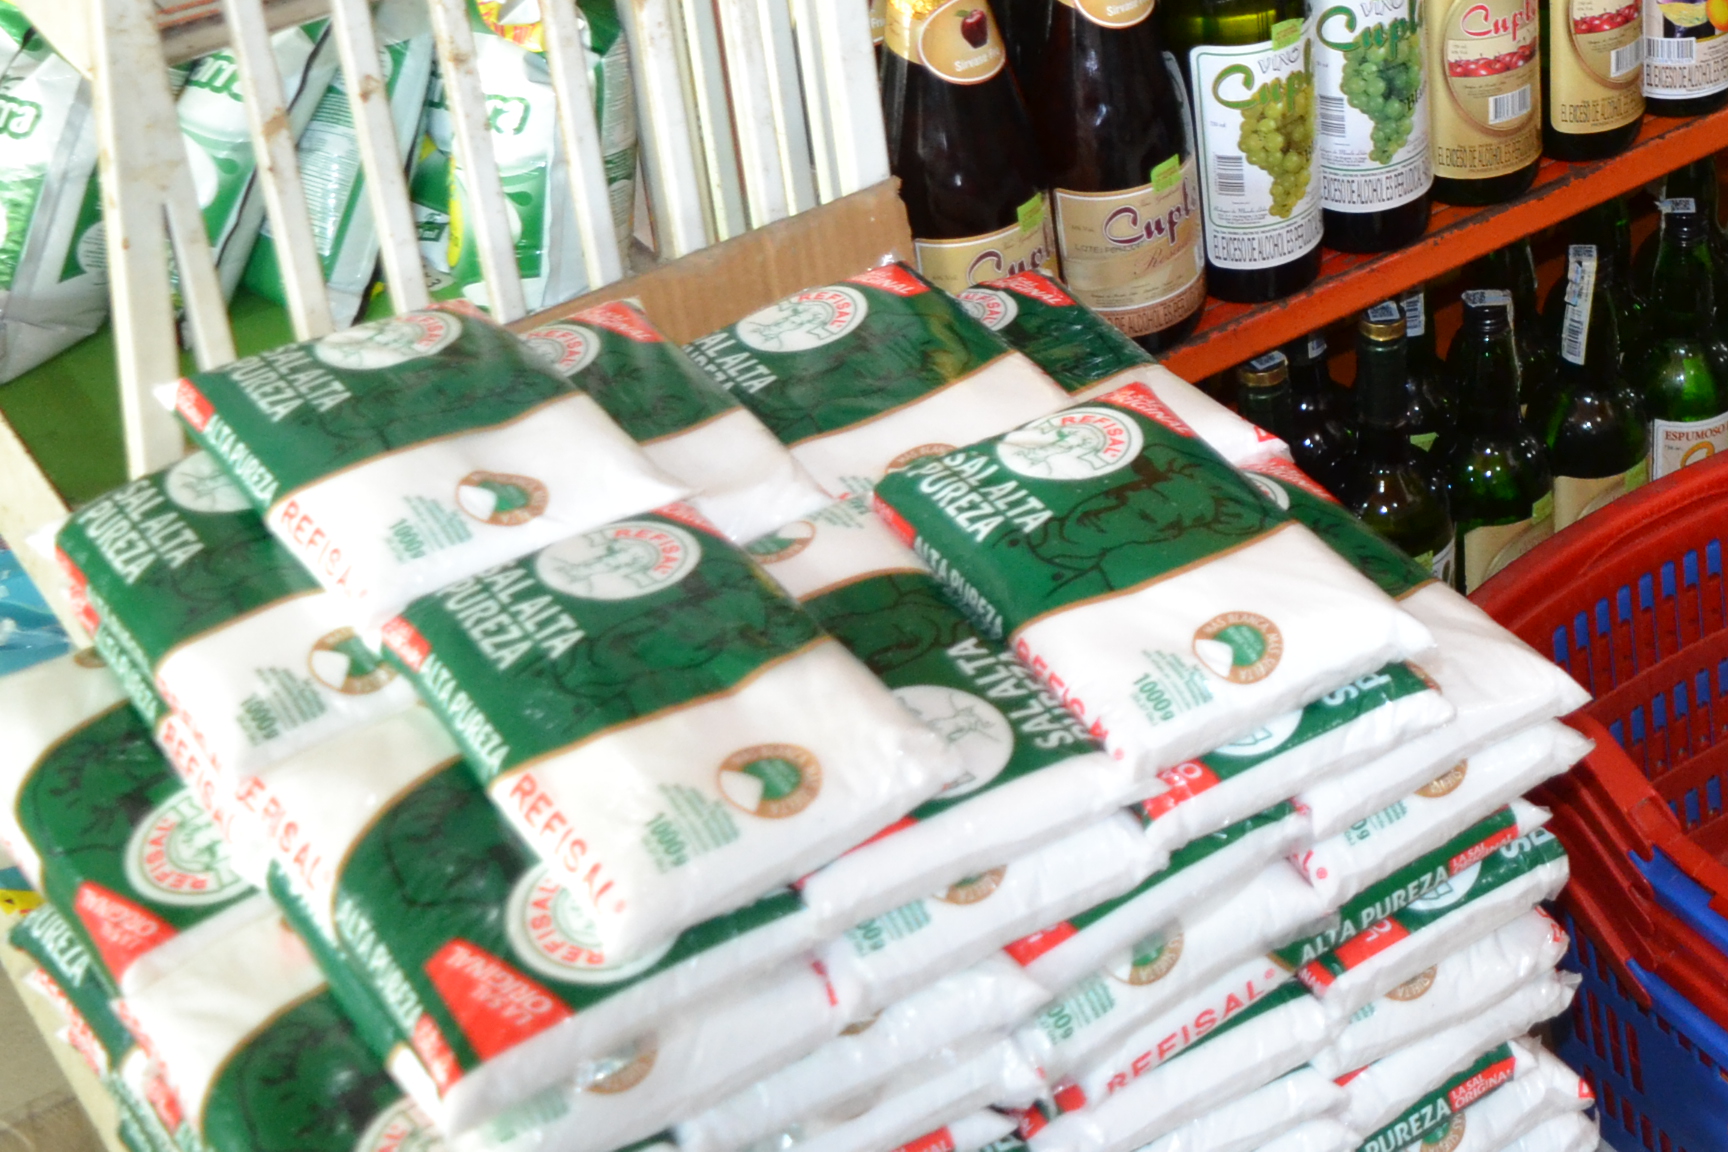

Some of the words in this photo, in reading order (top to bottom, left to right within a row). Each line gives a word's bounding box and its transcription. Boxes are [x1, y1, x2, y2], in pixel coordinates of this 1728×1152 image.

[799, 291, 852, 329] REFISAL
[227, 358, 305, 423] PUREZA
[290, 356, 352, 413] ALTA
[716, 354, 778, 394] ALTA
[1060, 414, 1126, 461] REFISAL
[907, 459, 1006, 543] PUREZA
[945, 447, 1000, 485] SAL
[988, 480, 1054, 534] ALTA
[78, 500, 158, 585] PUREZA
[116, 478, 163, 526] SAL
[146, 507, 205, 569] ALTA
[613, 528, 684, 576] REFISAL
[439, 578, 534, 672] PUREZA
[510, 595, 586, 660] ALTA
[420, 654, 457, 705] ALTA
[450, 692, 510, 774] PUREZA
[1133, 672, 1176, 724] 1000g
[1300, 923, 1357, 965] ALTA
[1361, 865, 1452, 923] PUREZA
[1105, 979, 1267, 1095] REFISAL
[1451, 1088, 1465, 1103] LA
[1465, 1073, 1487, 1097] SAL
[1454, 1068, 1516, 1112] ORIGINAL
[1365, 1096, 1452, 1152] PUREZA
